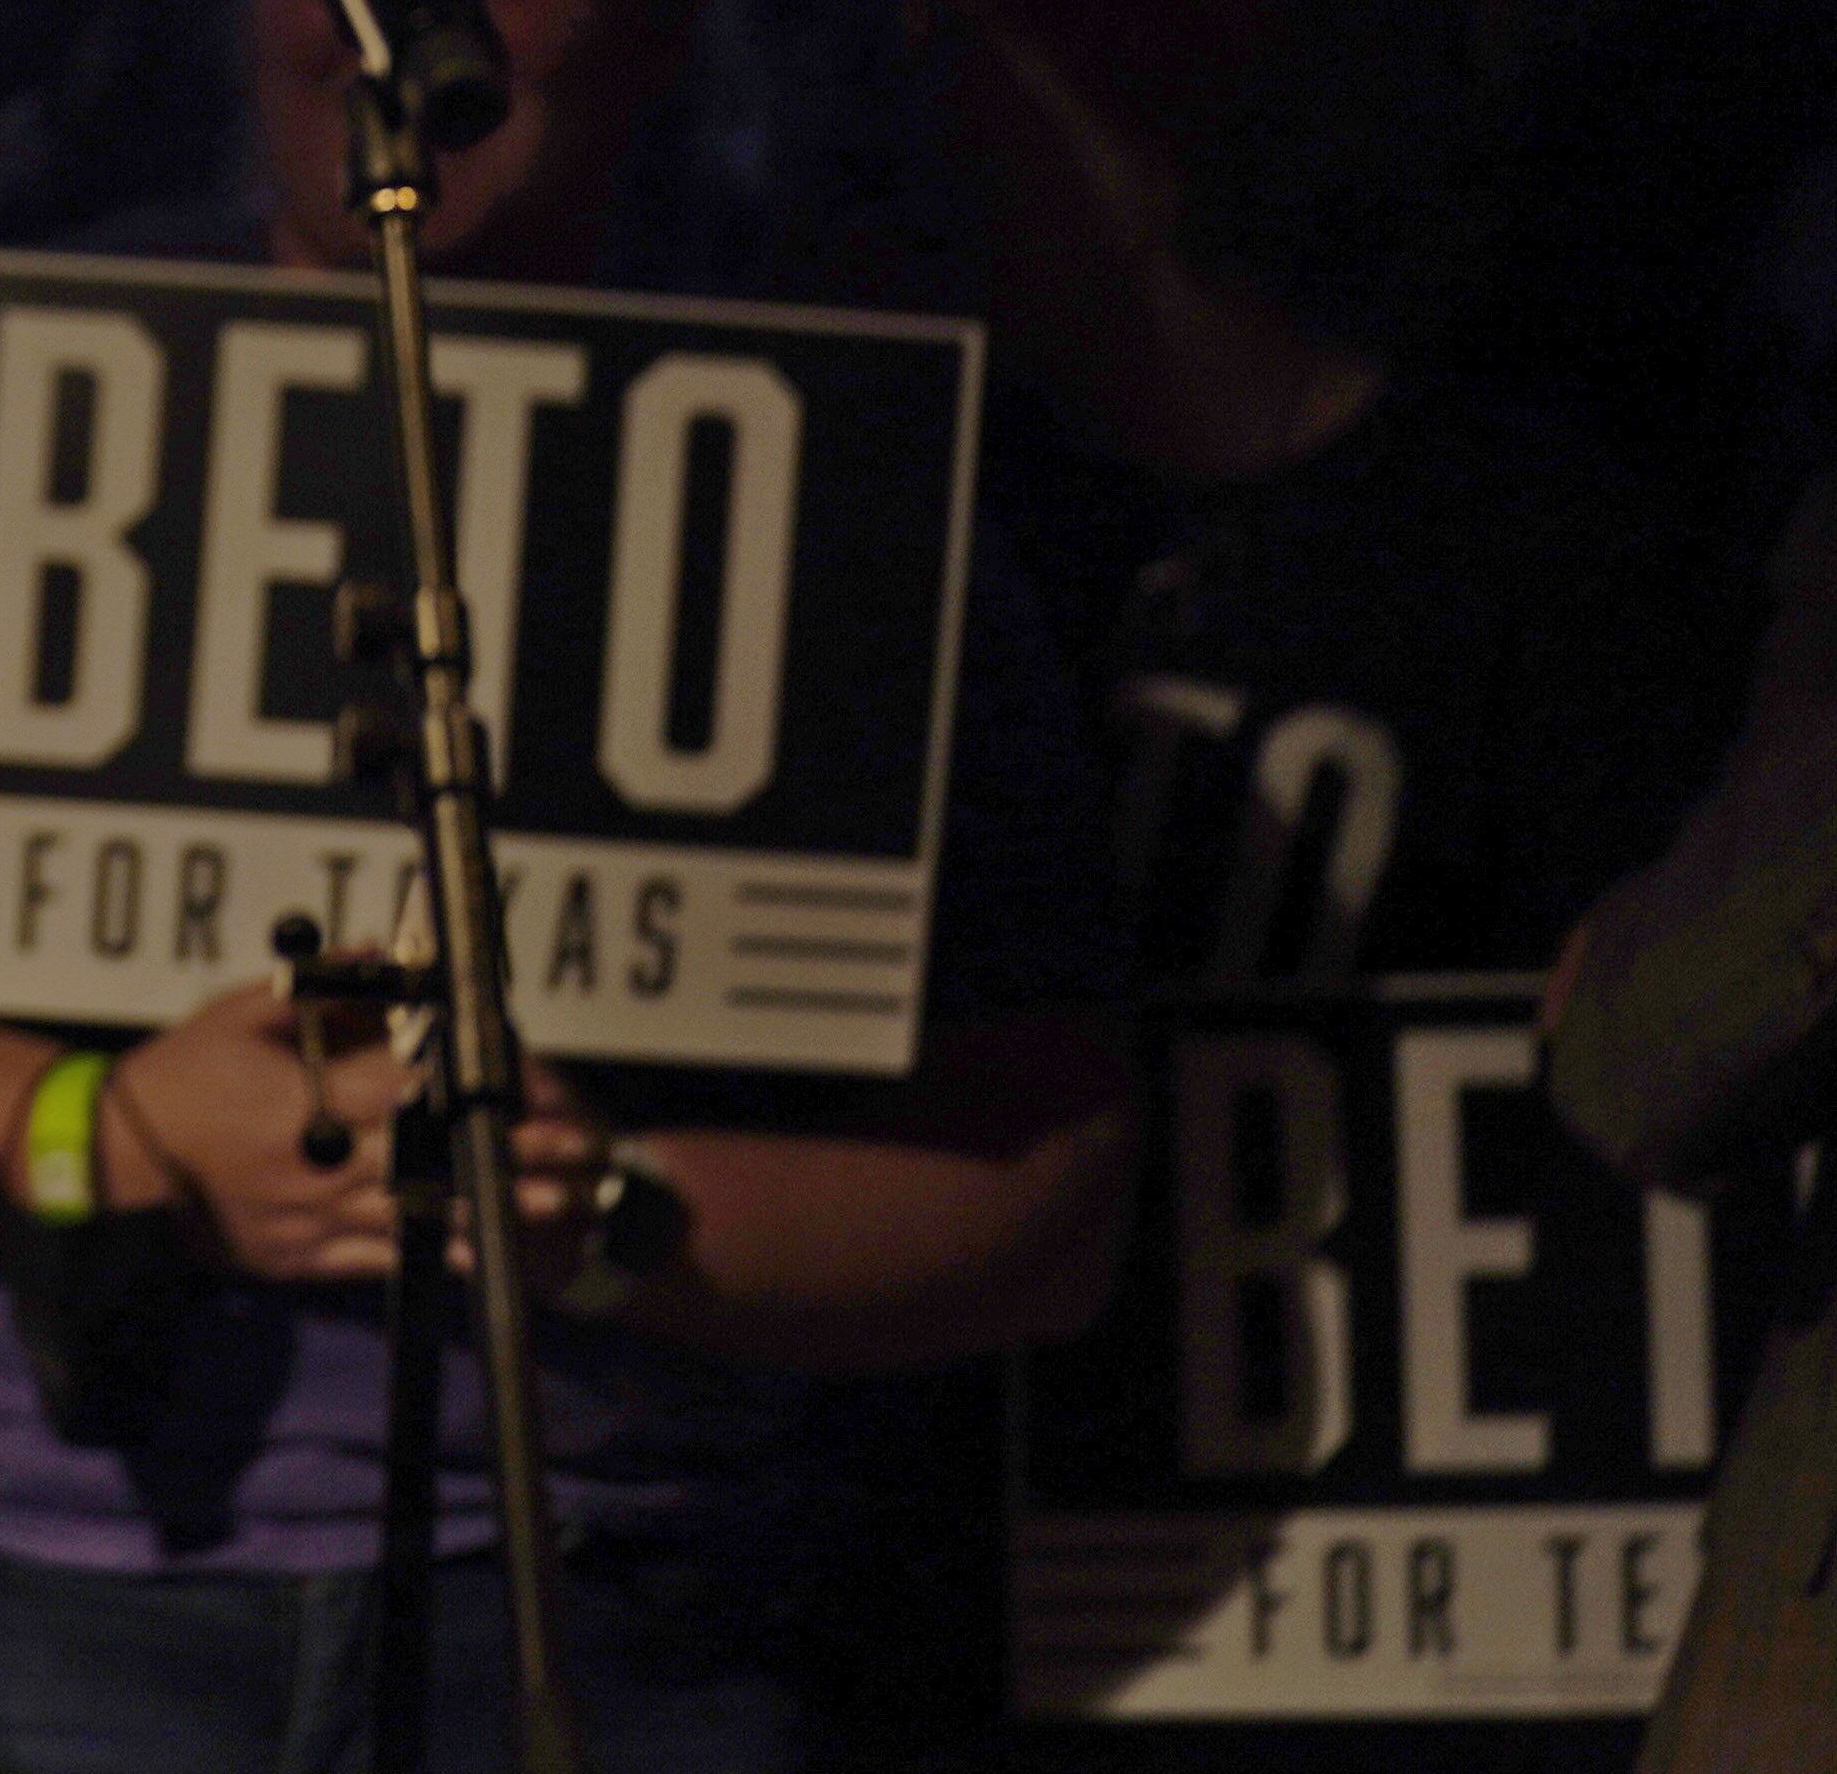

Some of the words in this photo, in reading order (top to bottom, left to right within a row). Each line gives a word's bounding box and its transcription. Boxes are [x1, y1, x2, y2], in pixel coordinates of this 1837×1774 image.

[18, 832, 228, 966] FOR
[315, 848, 686, 1000] TAS
[1248, 1533, 1457, 1662] FOR
